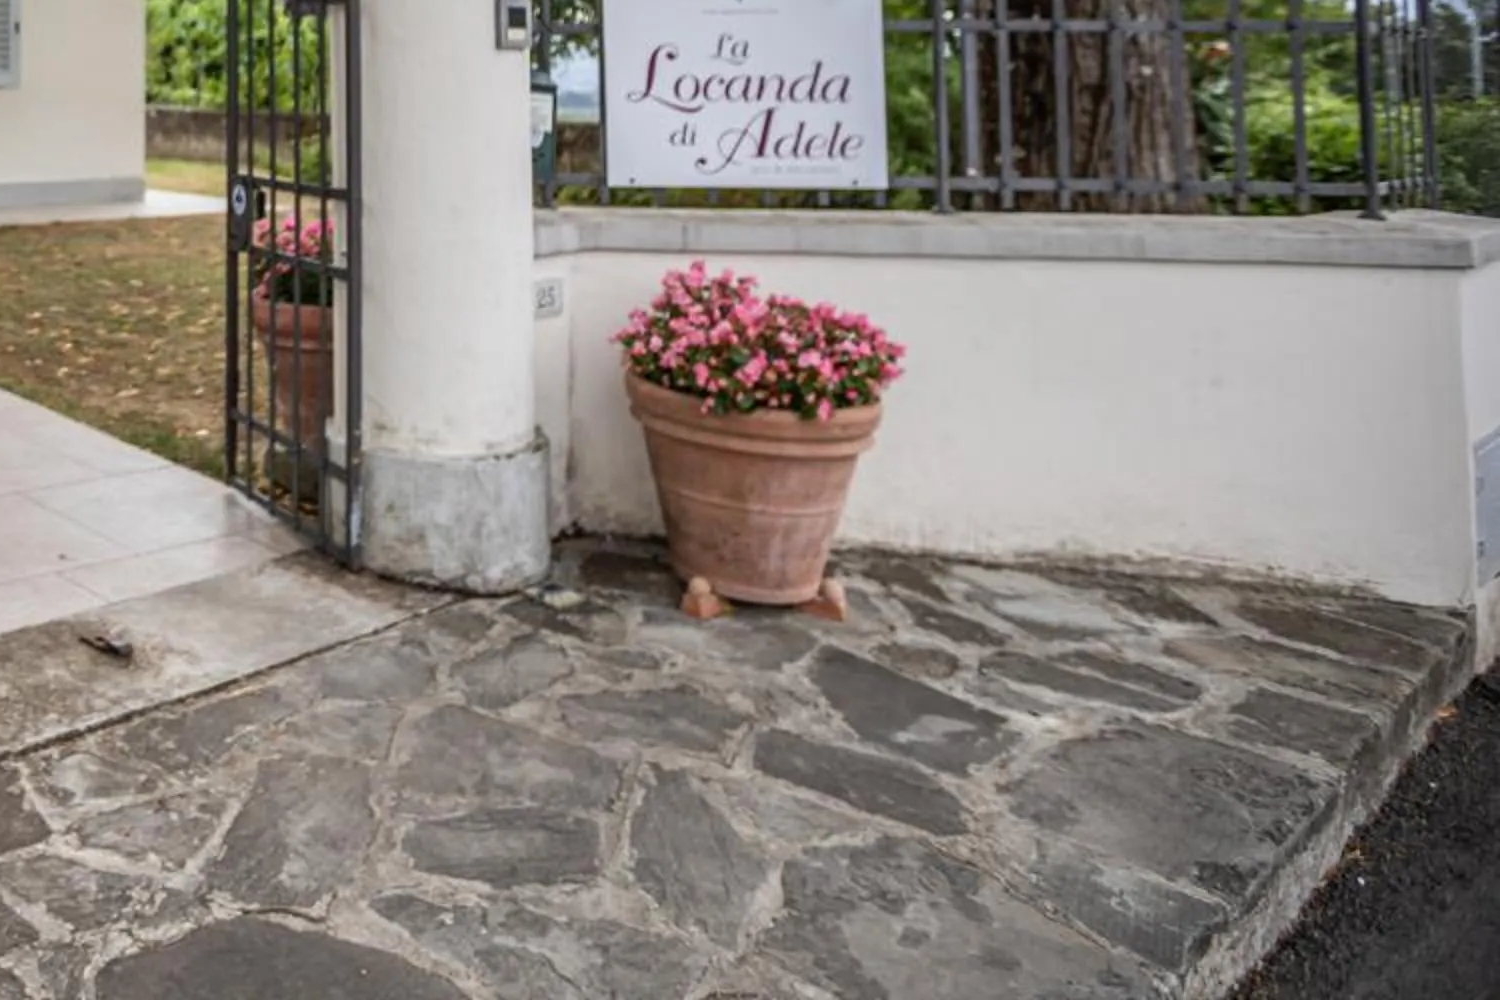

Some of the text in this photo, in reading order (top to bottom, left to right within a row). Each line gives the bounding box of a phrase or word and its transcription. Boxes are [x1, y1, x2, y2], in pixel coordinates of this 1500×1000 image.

[628, 43, 851, 113] Locanda
[711, 33, 750, 65] La
[669, 107, 864, 174] di Adele
